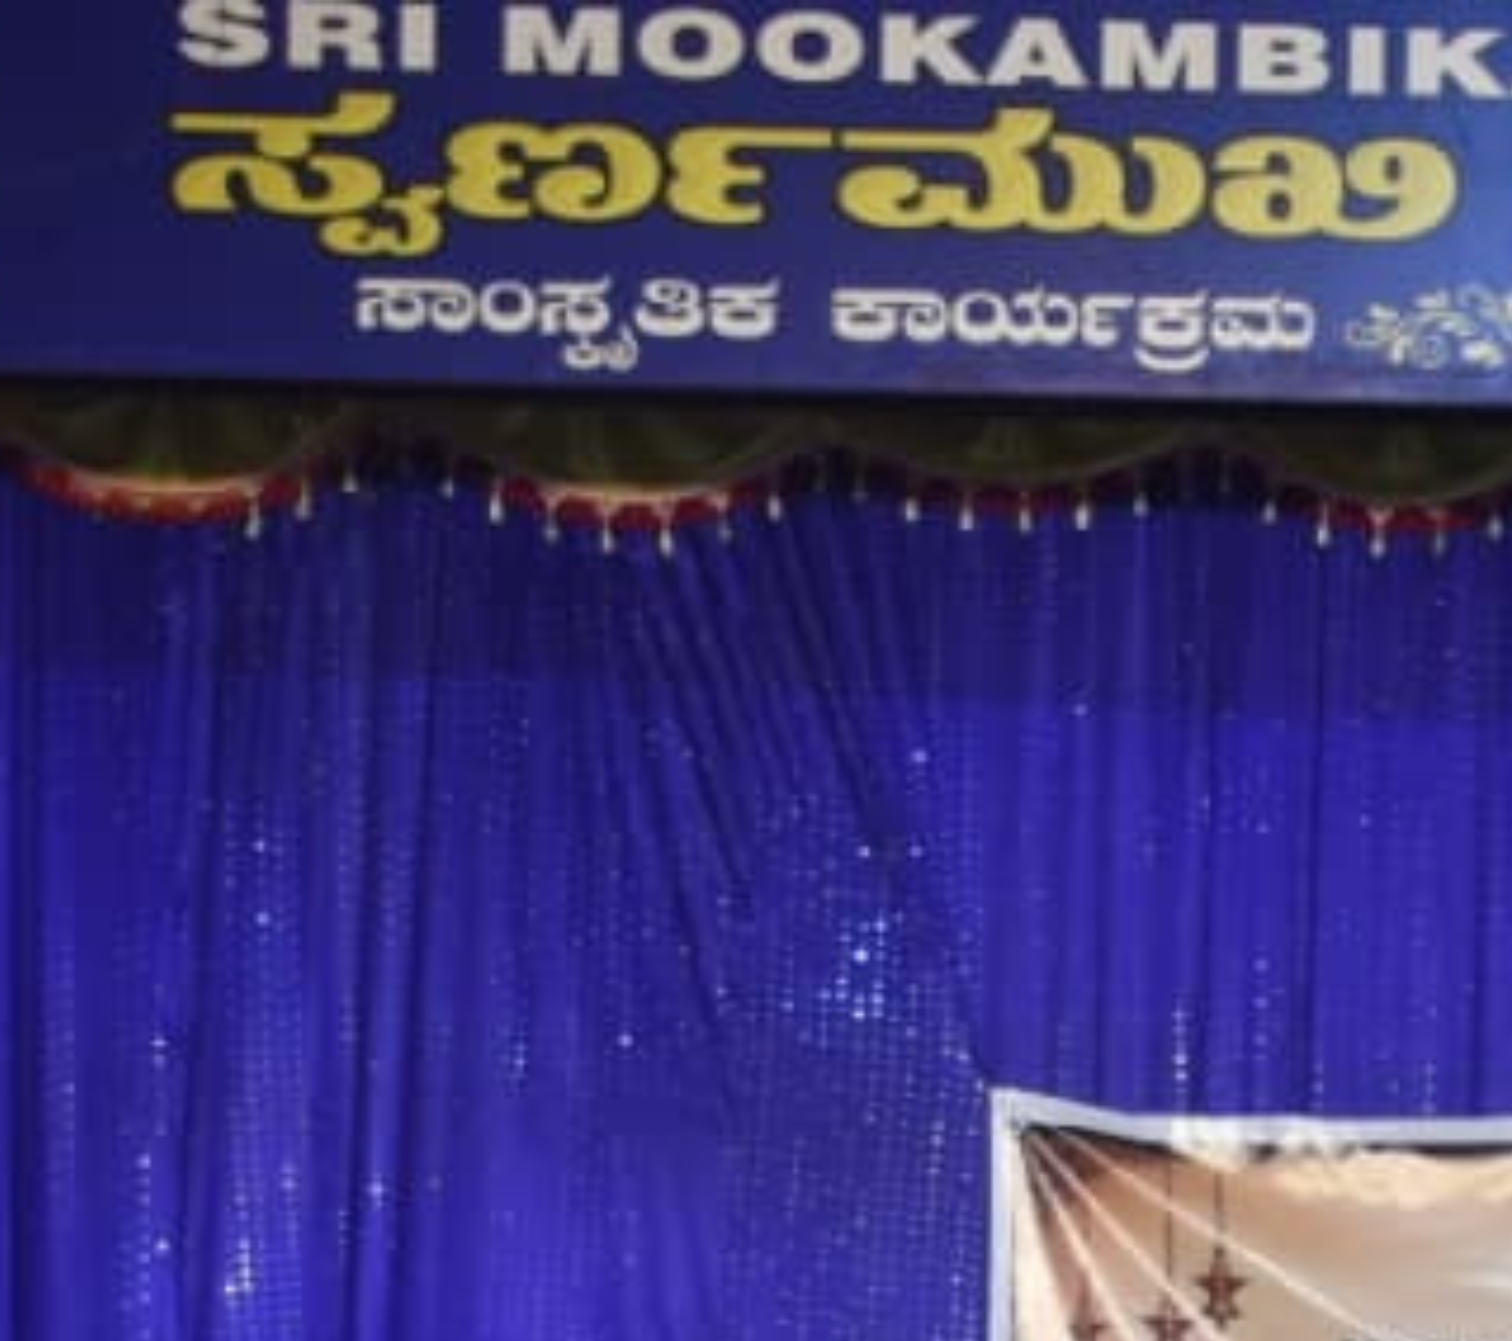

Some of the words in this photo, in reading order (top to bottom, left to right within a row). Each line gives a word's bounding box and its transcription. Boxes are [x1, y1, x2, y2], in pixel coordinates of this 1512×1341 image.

[179, 0, 437, 72] SRI
[171, 92, 1458, 256] ಸ್ವರ್ಣಮುಖಿ
[355, 276, 780, 371] ಸಾಂಸ್ಕೃತಿಕ
[830, 285, 1316, 373] ಕಾರ್ಯಕ್ರಮ
